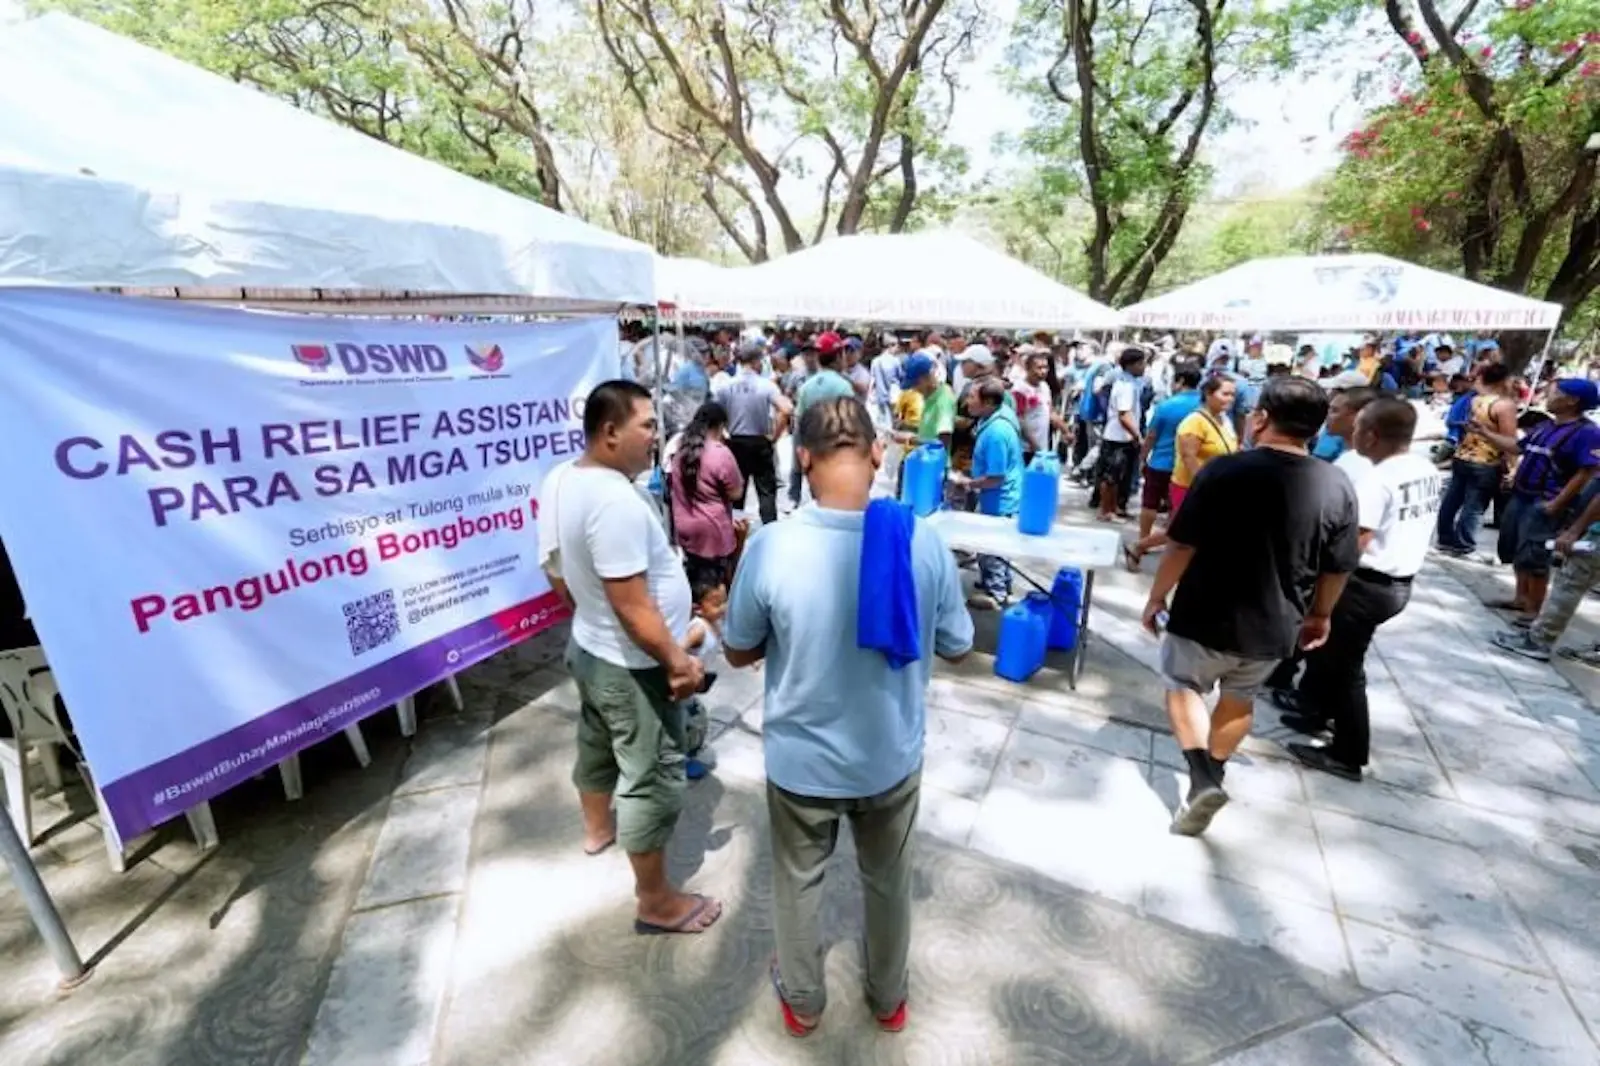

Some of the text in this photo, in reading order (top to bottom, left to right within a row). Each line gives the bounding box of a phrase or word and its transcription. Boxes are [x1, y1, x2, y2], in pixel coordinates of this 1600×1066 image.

[335, 342, 448, 375] DSWD
[54, 427, 242, 480] CASH
[261, 413, 421, 459] RELIEF
[147, 429, 585, 527] PARA SA MGA TSUPER
[289, 482, 532, 548] Serbisyo at Tulong mula kay
[130, 545, 370, 635] Pangulong
[376, 506, 526, 562] Bongbong
